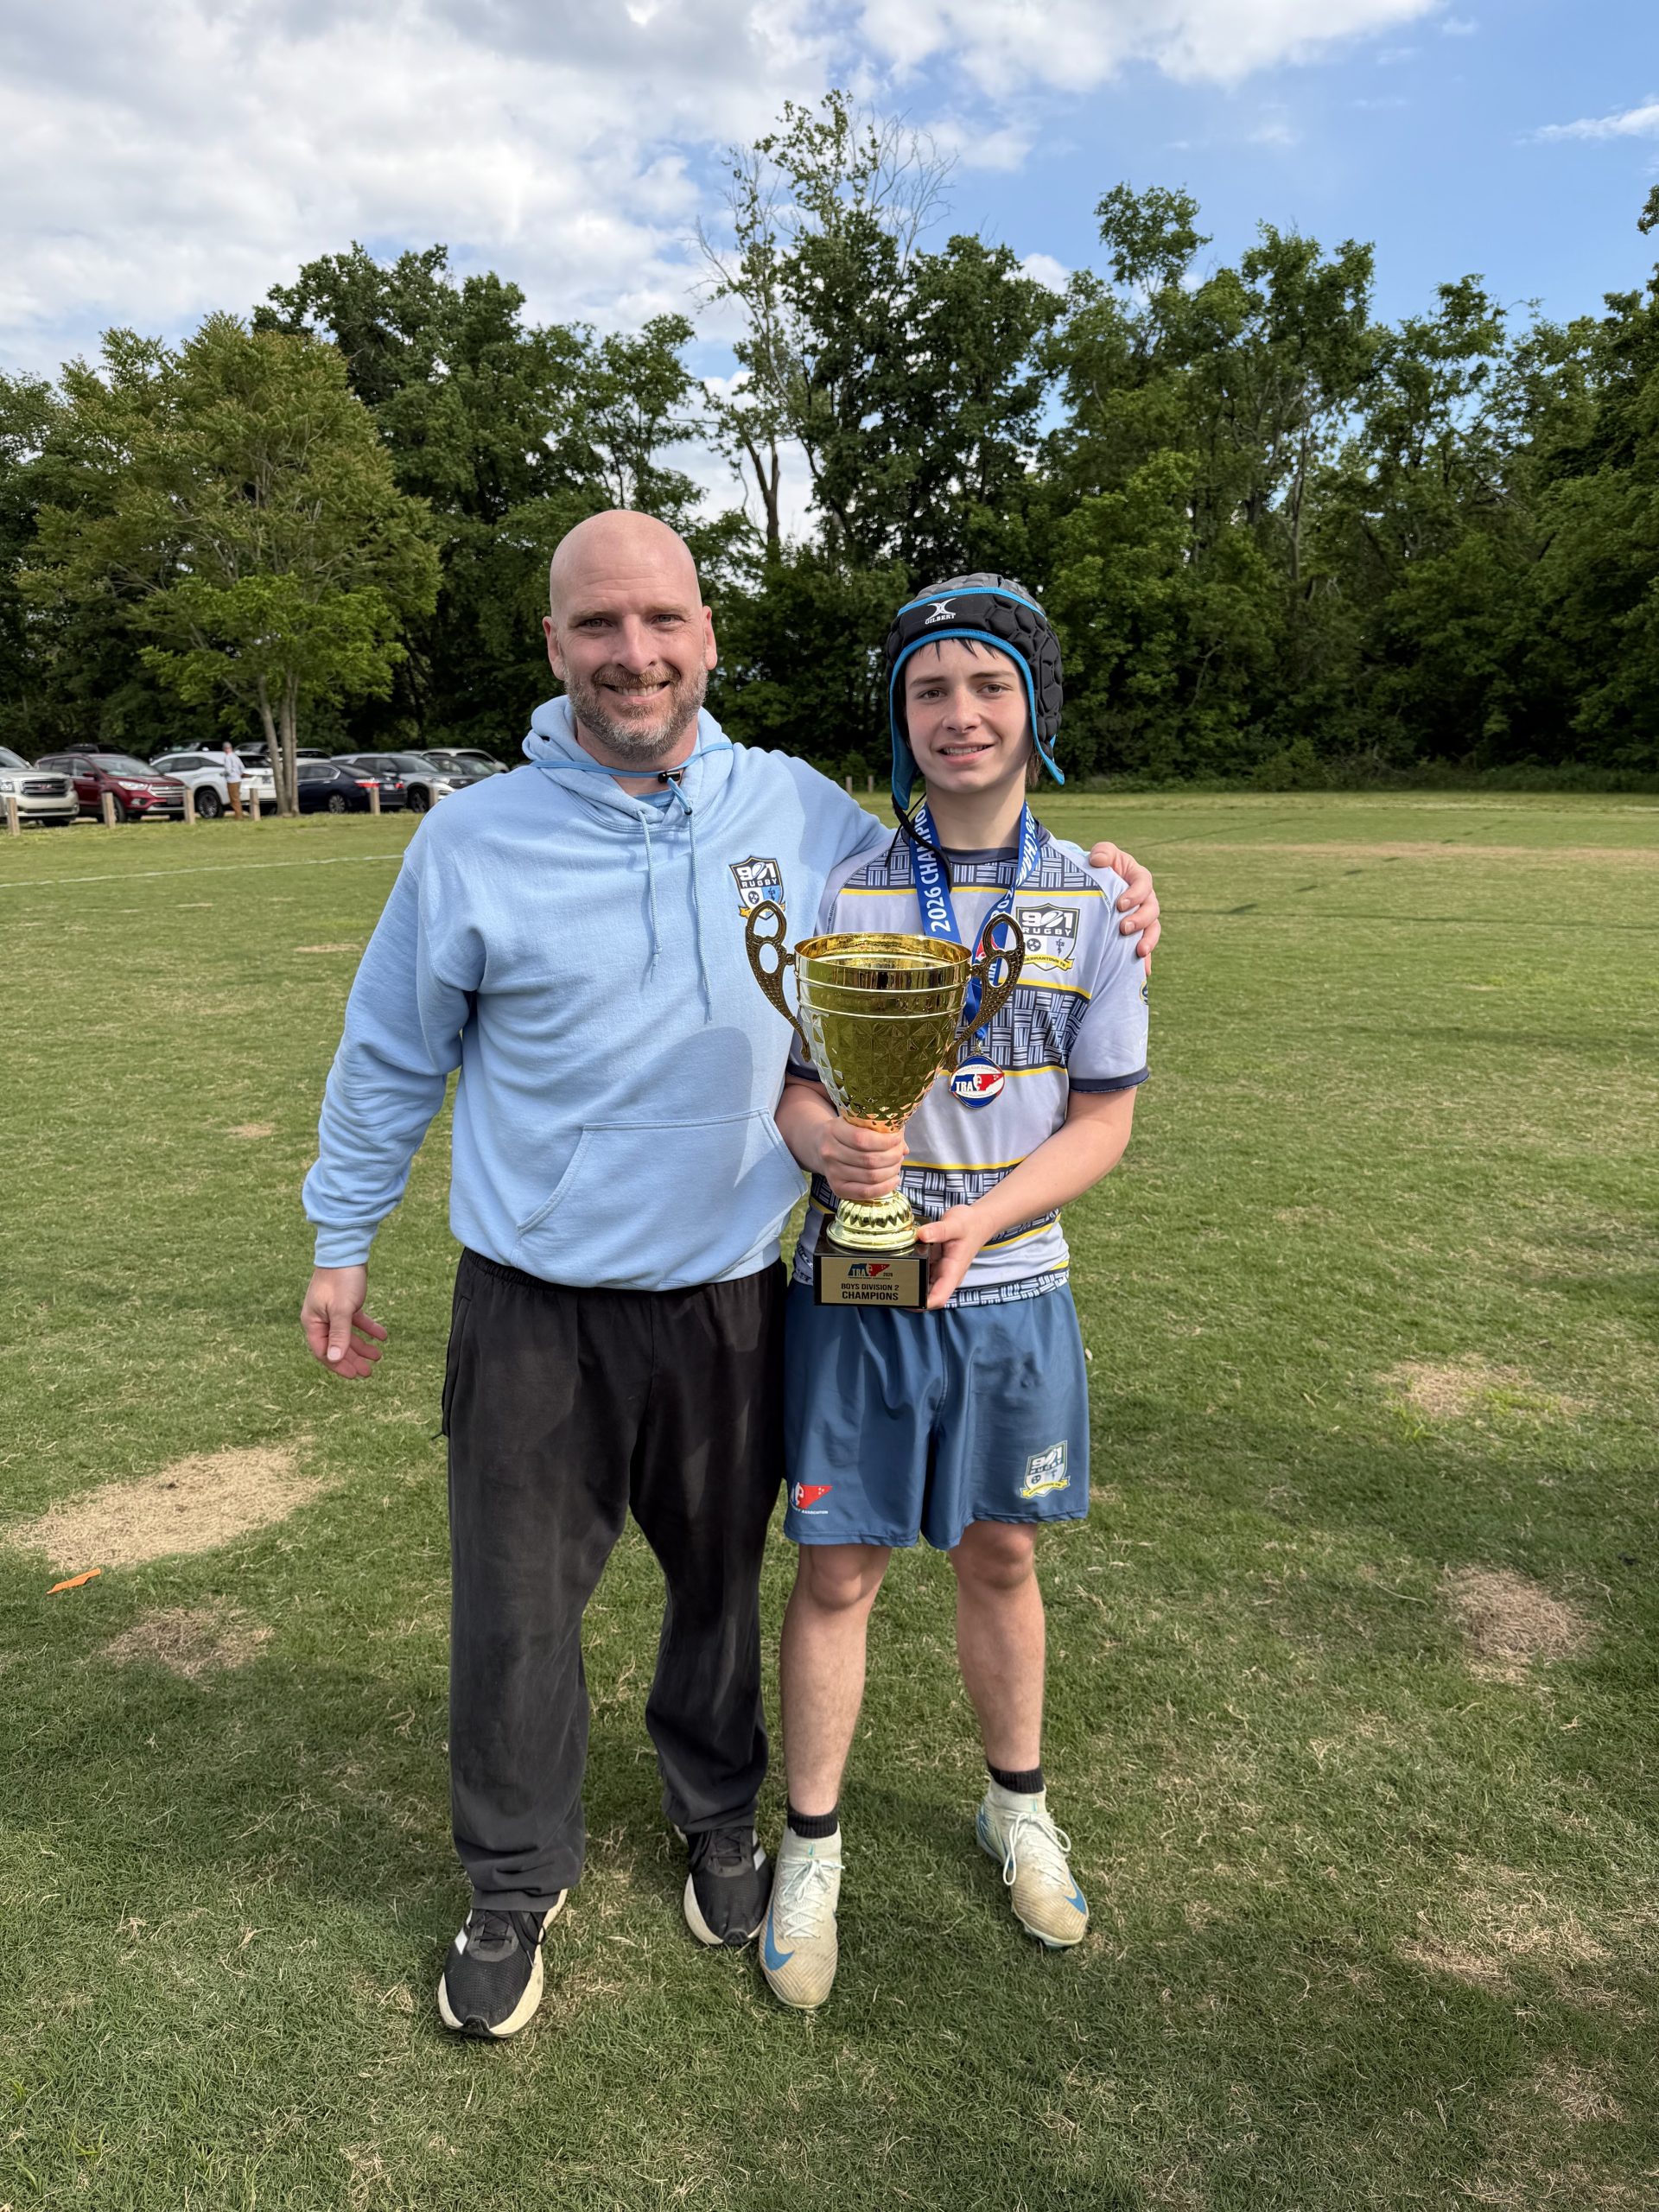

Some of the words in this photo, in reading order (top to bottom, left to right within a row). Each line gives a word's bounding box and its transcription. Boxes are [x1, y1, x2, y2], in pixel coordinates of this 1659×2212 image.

[925, 613, 957, 625] GILBERT
[741, 878, 778, 888] RUGBY
[924, 886, 951, 932] 2026
[1022, 926, 1071, 937] RUGBY
[955, 1081, 973, 1091] TRA
[842, 1292, 899, 1300] CHAMPIONS
